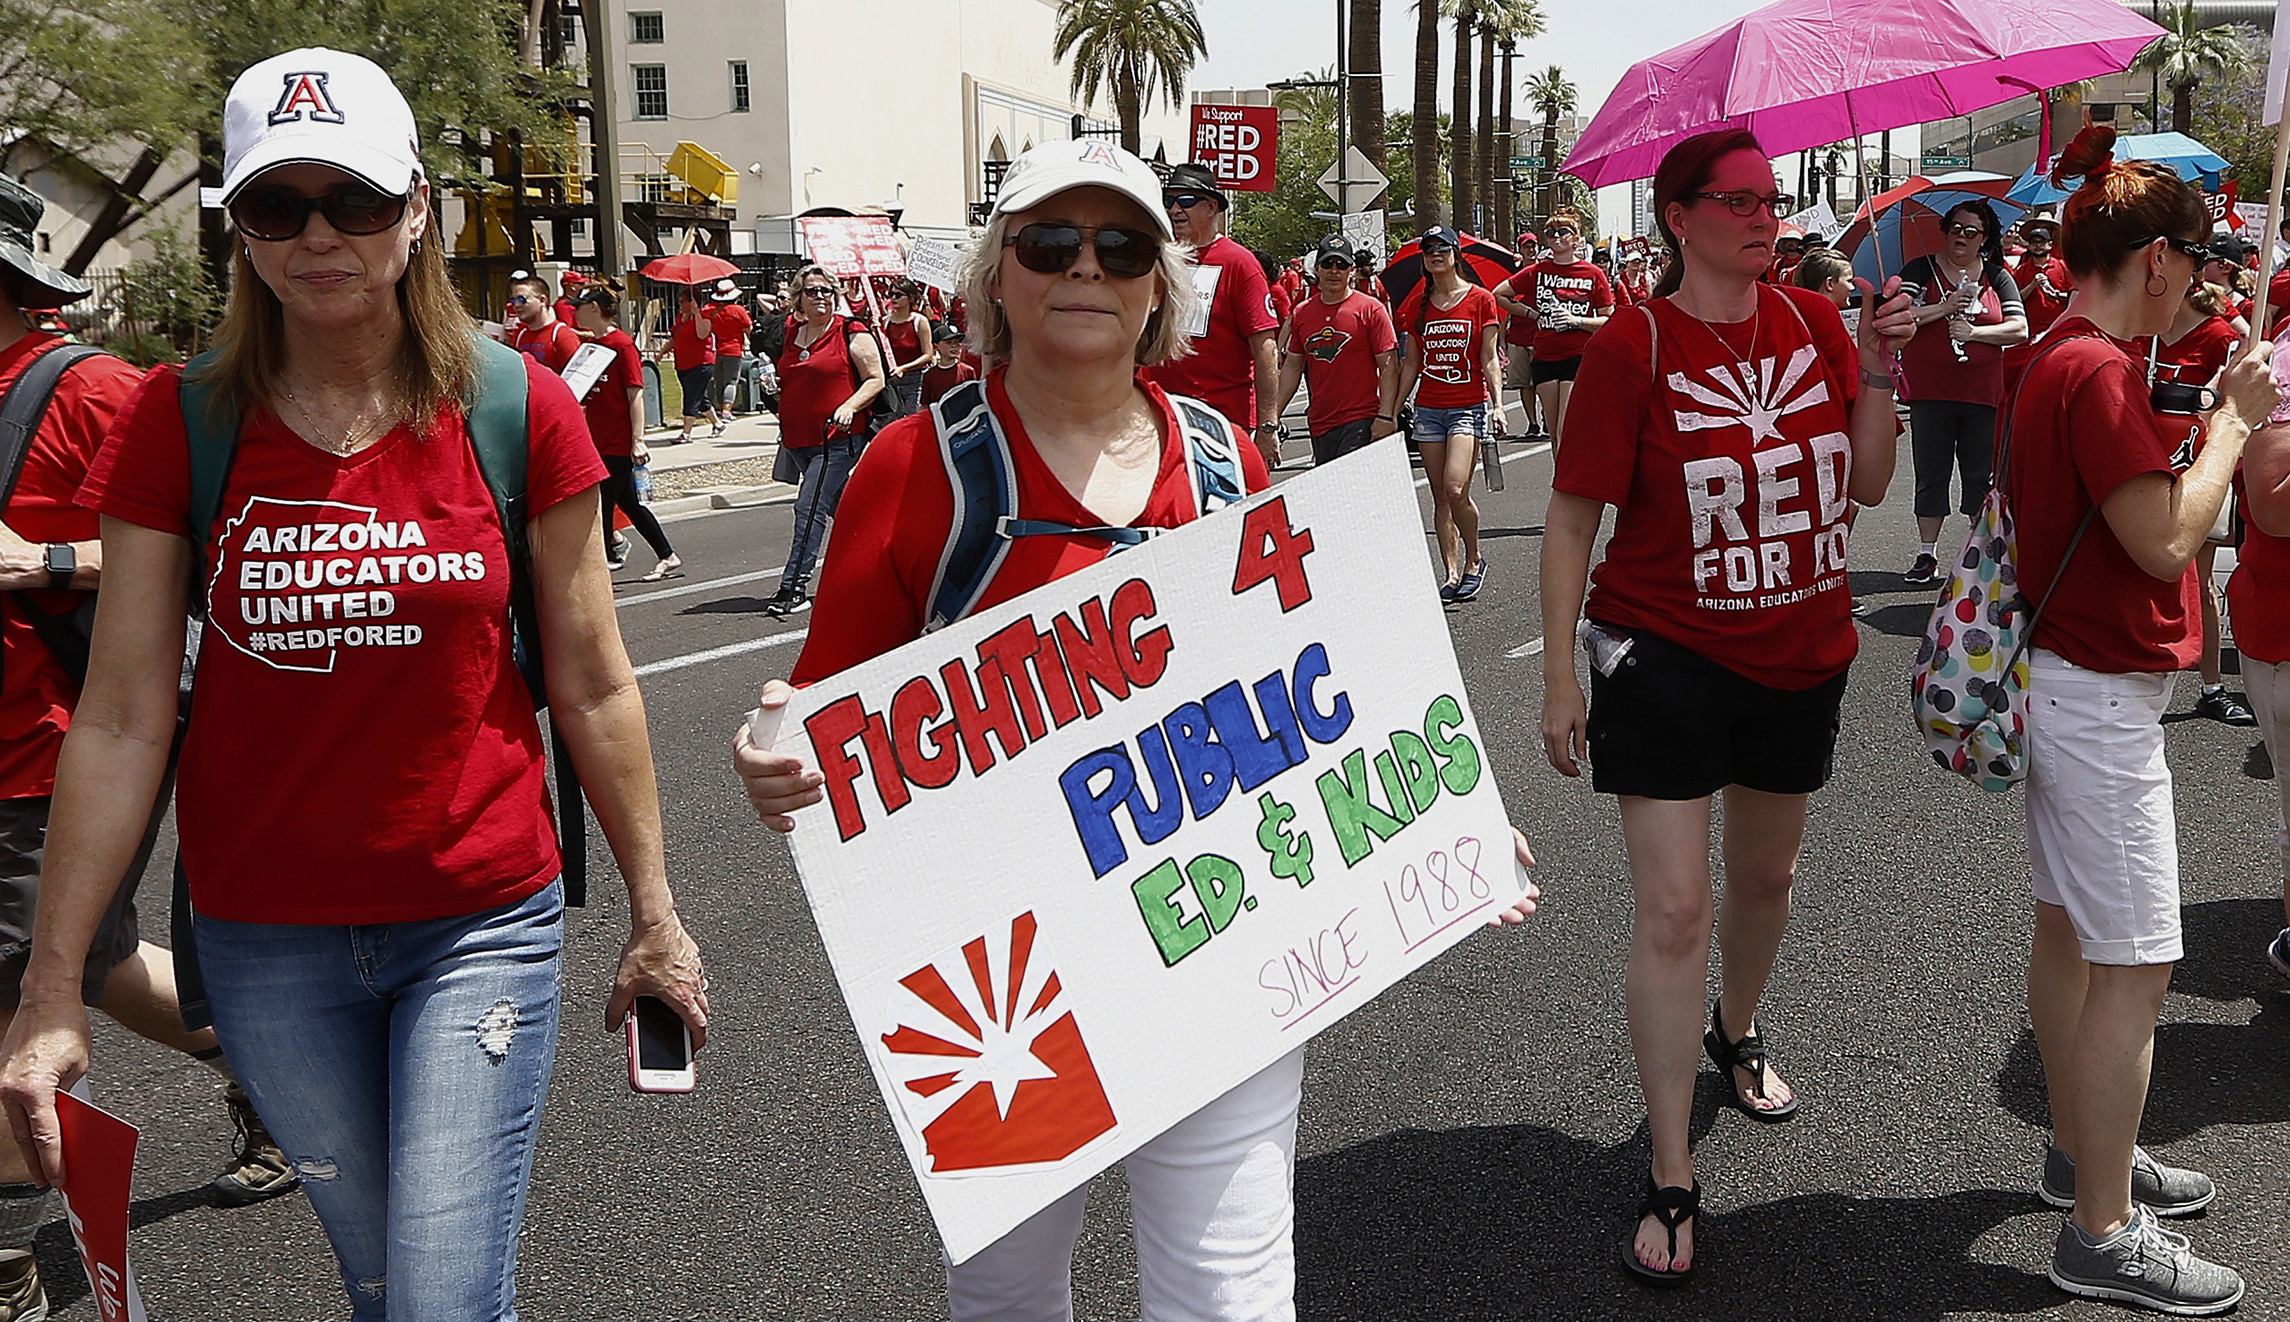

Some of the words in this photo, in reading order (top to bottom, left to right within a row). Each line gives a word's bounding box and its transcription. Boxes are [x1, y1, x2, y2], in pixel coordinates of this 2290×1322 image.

[268, 71, 345, 126] A
[1211, 107, 1244, 124] Support
[1196, 123, 1261, 151] #RED
[1078, 140, 1123, 173] A
[1536, 271, 1542, 286] I
[1543, 273, 1593, 291] Wanna
[1536, 285, 1553, 300] Be
[1425, 338, 1467, 349] EDUCATORS
[1427, 323, 1466, 335] ARIZONA
[1435, 353, 1461, 362] UNITED
[1683, 431, 1853, 549] RED
[243, 521, 427, 554] ARIZONA
[239, 551, 487, 590] EDUCATORS
[1693, 540, 1792, 593] FOR
[240, 590, 396, 625] UNITED
[1696, 597, 1755, 611] ARIZONA
[1817, 574, 1845, 593] UNITE
[249, 624, 423, 651] #REDFORED
[803, 577, 1174, 843] FIGHTING
[1232, 494, 1315, 614] 4
[1058, 643, 1355, 879] PUBLIC
[1131, 852, 1259, 968] ED.
[1256, 790, 1315, 889] &
[1315, 693, 1482, 869] KIDS
[1258, 906, 1370, 1018] SINCE
[1383, 835, 1491, 946] 1988
